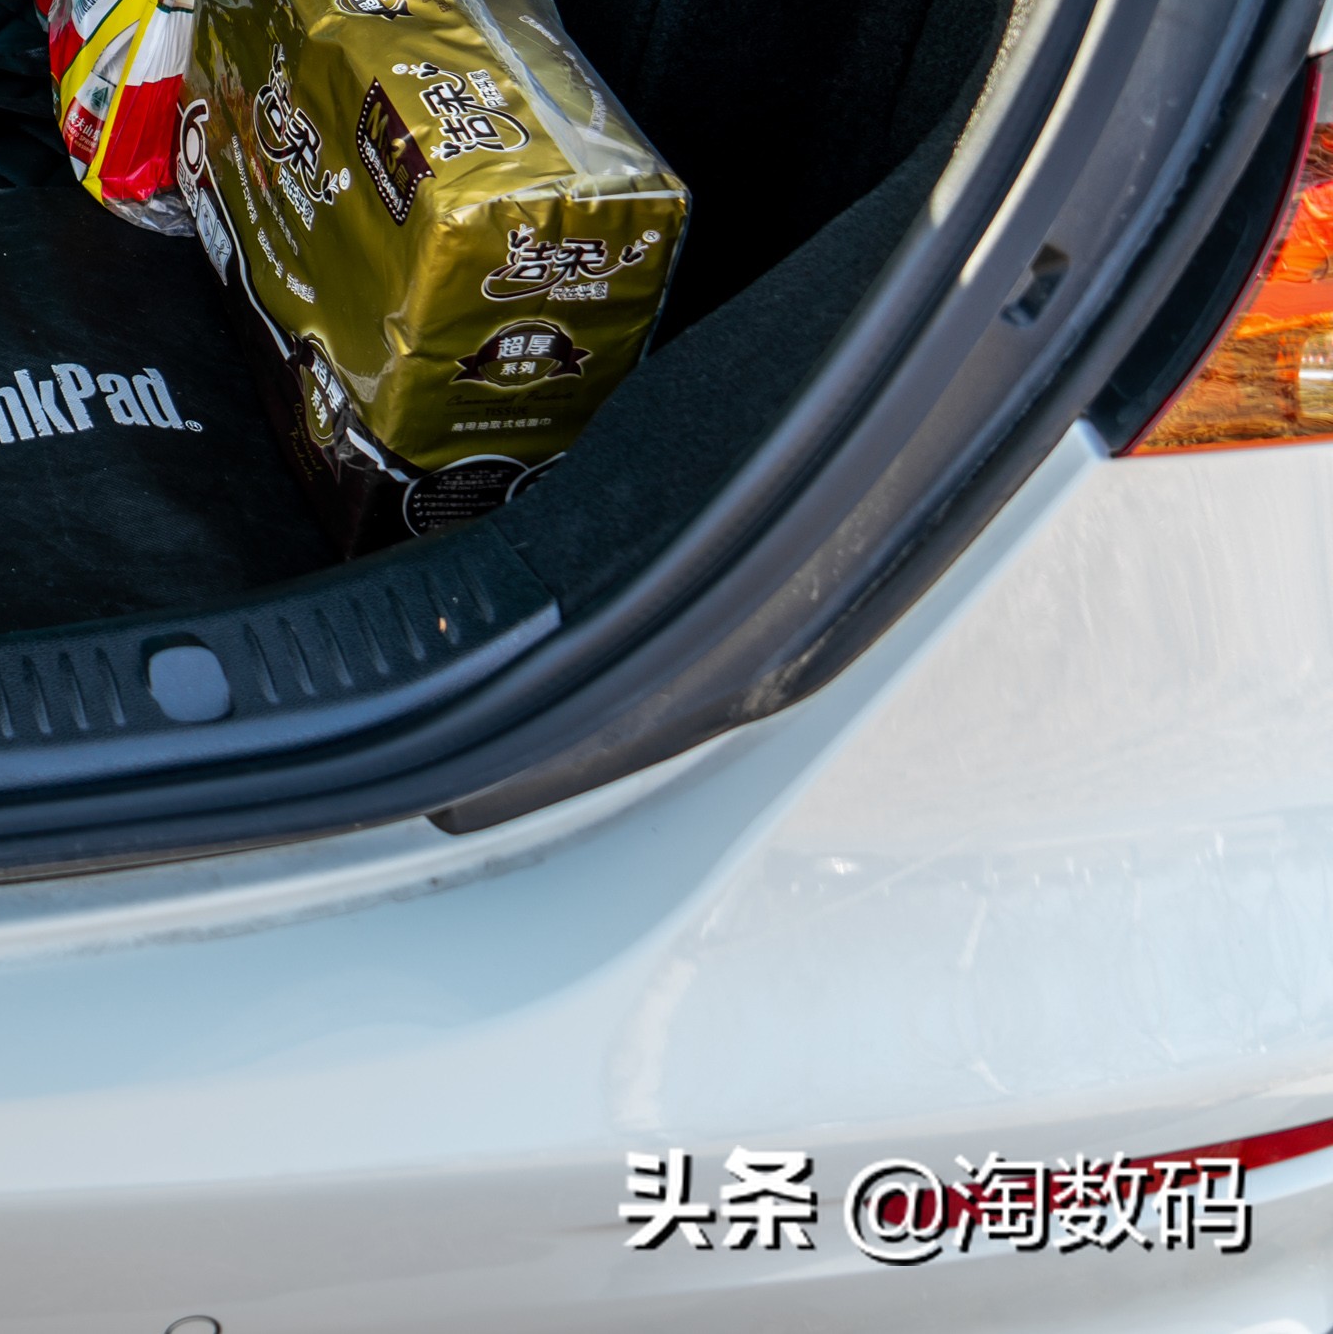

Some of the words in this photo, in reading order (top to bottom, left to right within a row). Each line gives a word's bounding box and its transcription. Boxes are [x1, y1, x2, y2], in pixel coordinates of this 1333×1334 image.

[417, 61, 532, 161] 洁柔
[481, 223, 650, 302] 洁柔
[496, 333, 556, 360] 超厚
[499, 361, 537, 377] 系列
[484, 405, 529, 416] TISSUE
